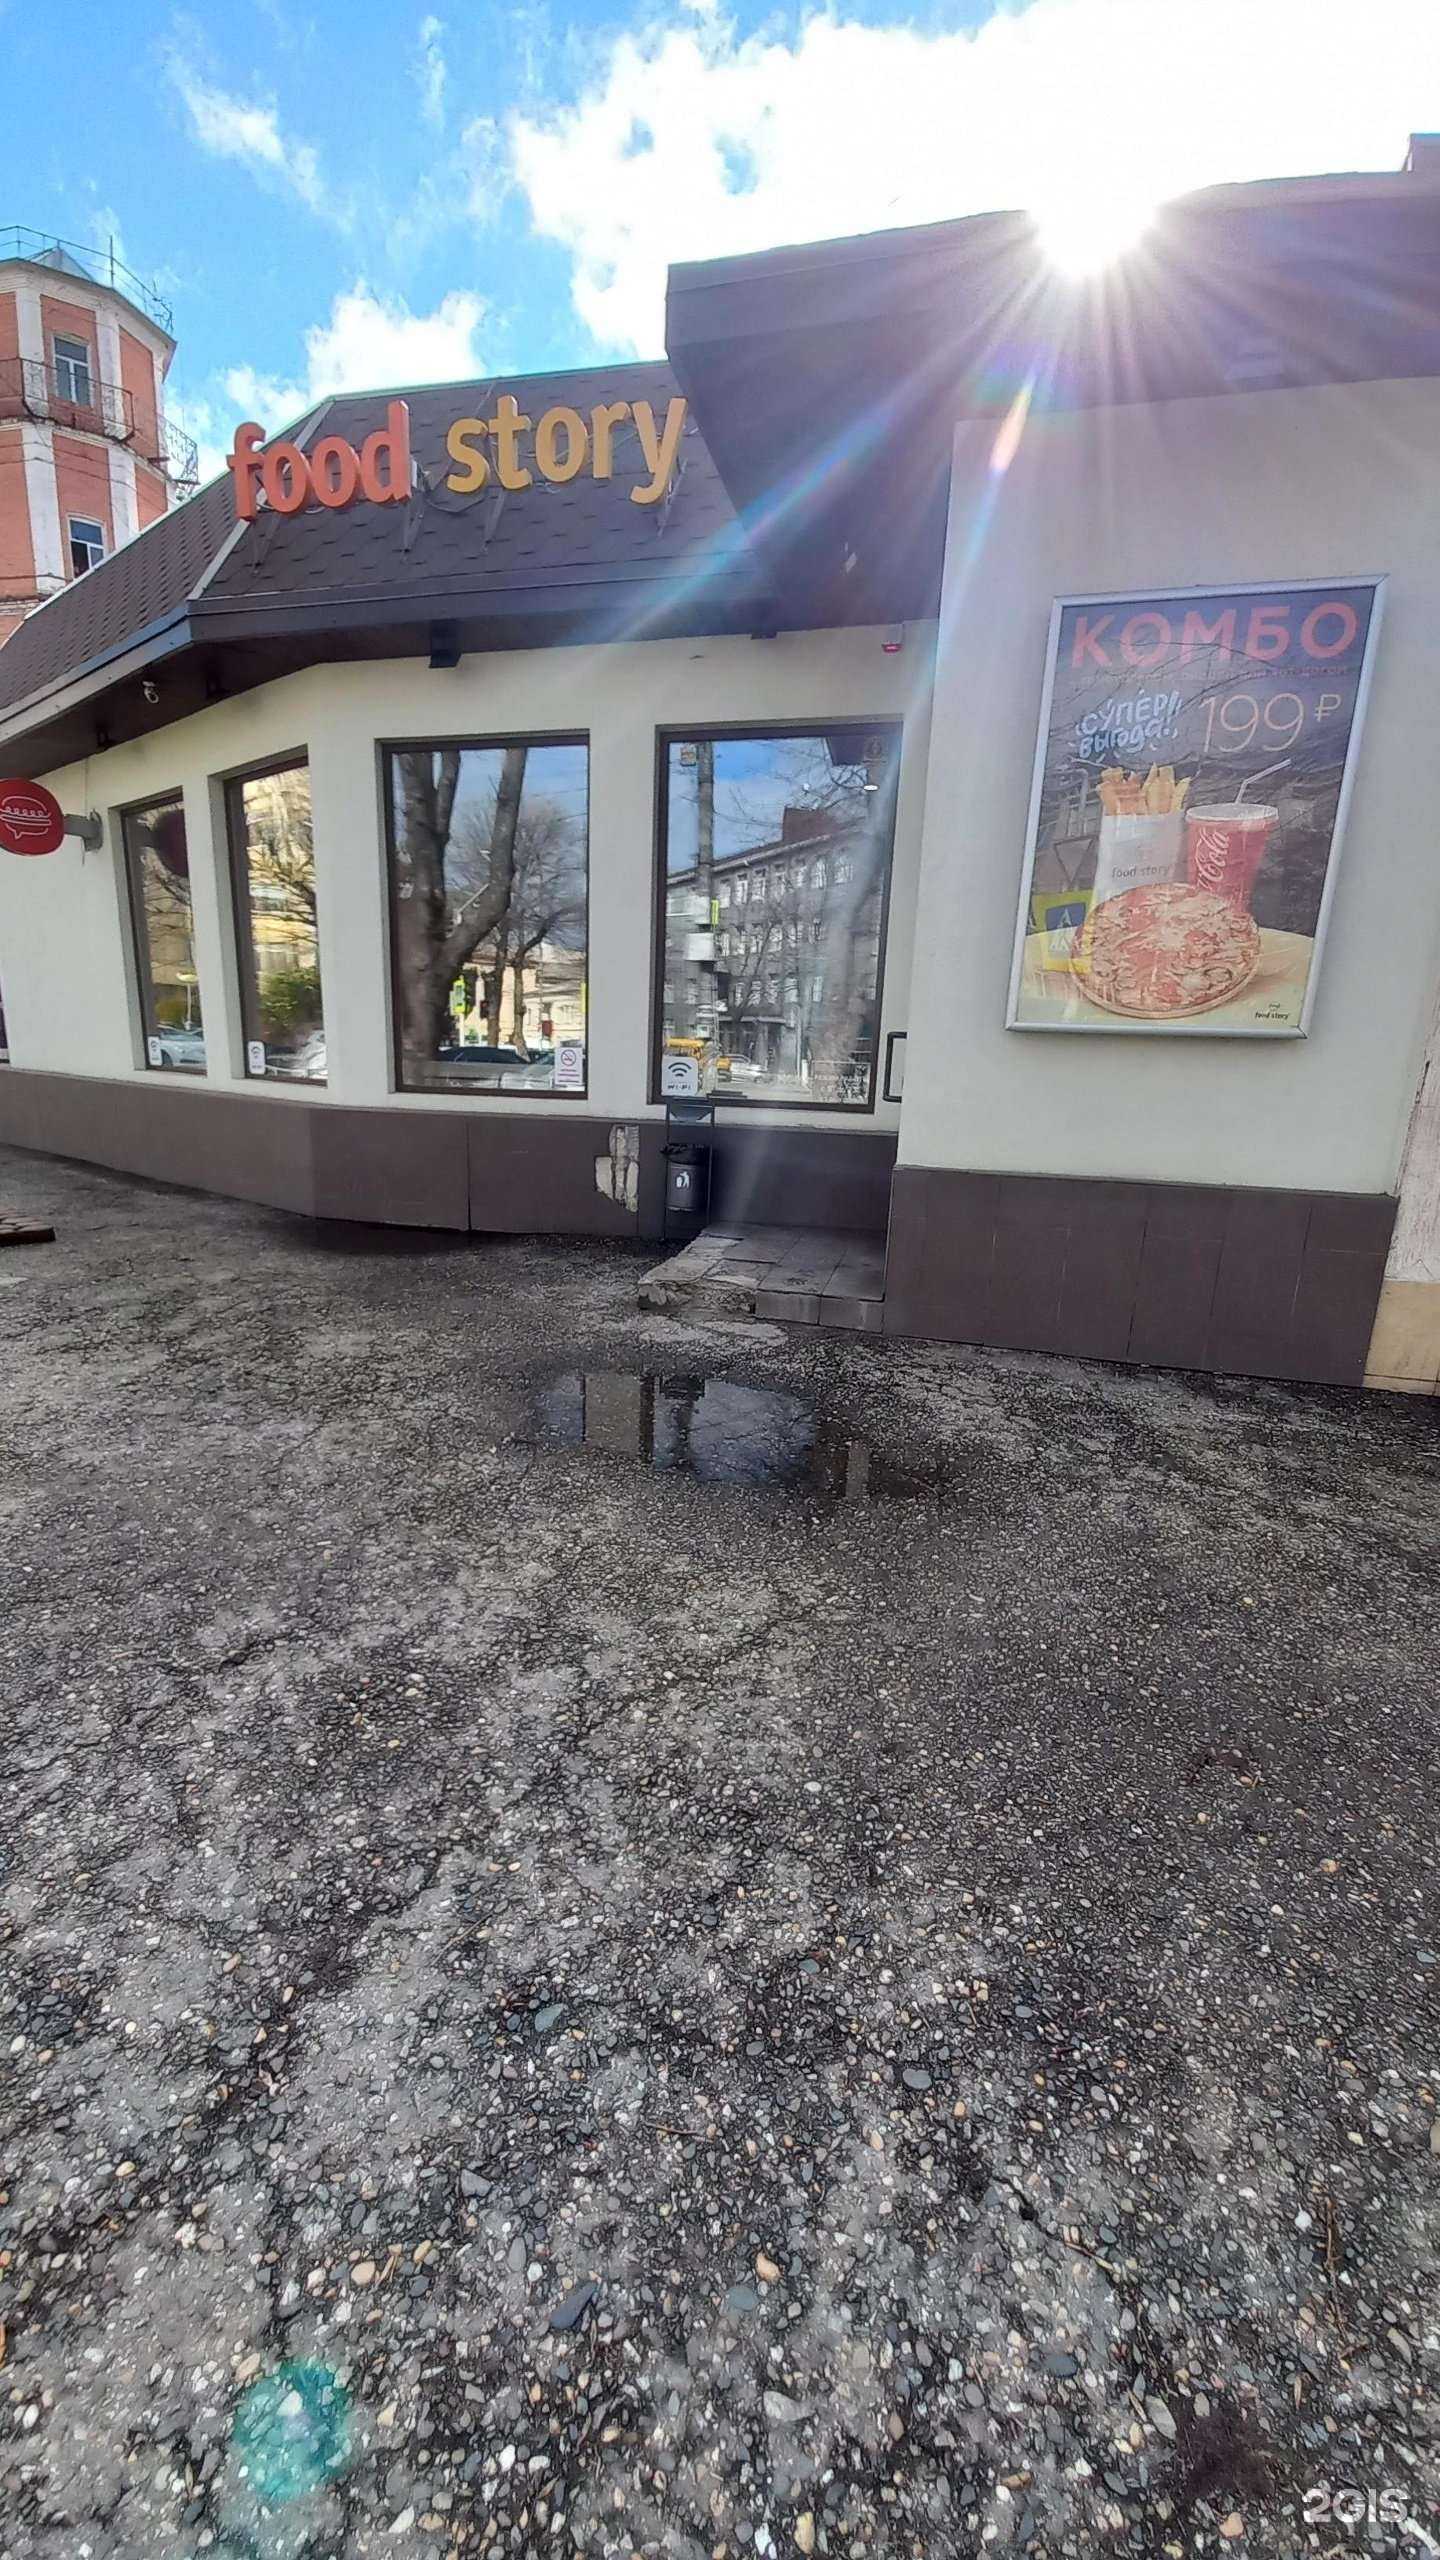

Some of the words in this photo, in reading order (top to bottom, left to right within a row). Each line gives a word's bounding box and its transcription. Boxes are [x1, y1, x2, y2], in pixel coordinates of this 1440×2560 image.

[226, 400, 412, 521] food
[446, 395, 687, 505] story
[1071, 601, 1360, 669] КОМБО
[1200, 693, 1305, 752] 199
[1111, 865, 1137, 879] food
[1140, 864, 1169, 879] story
